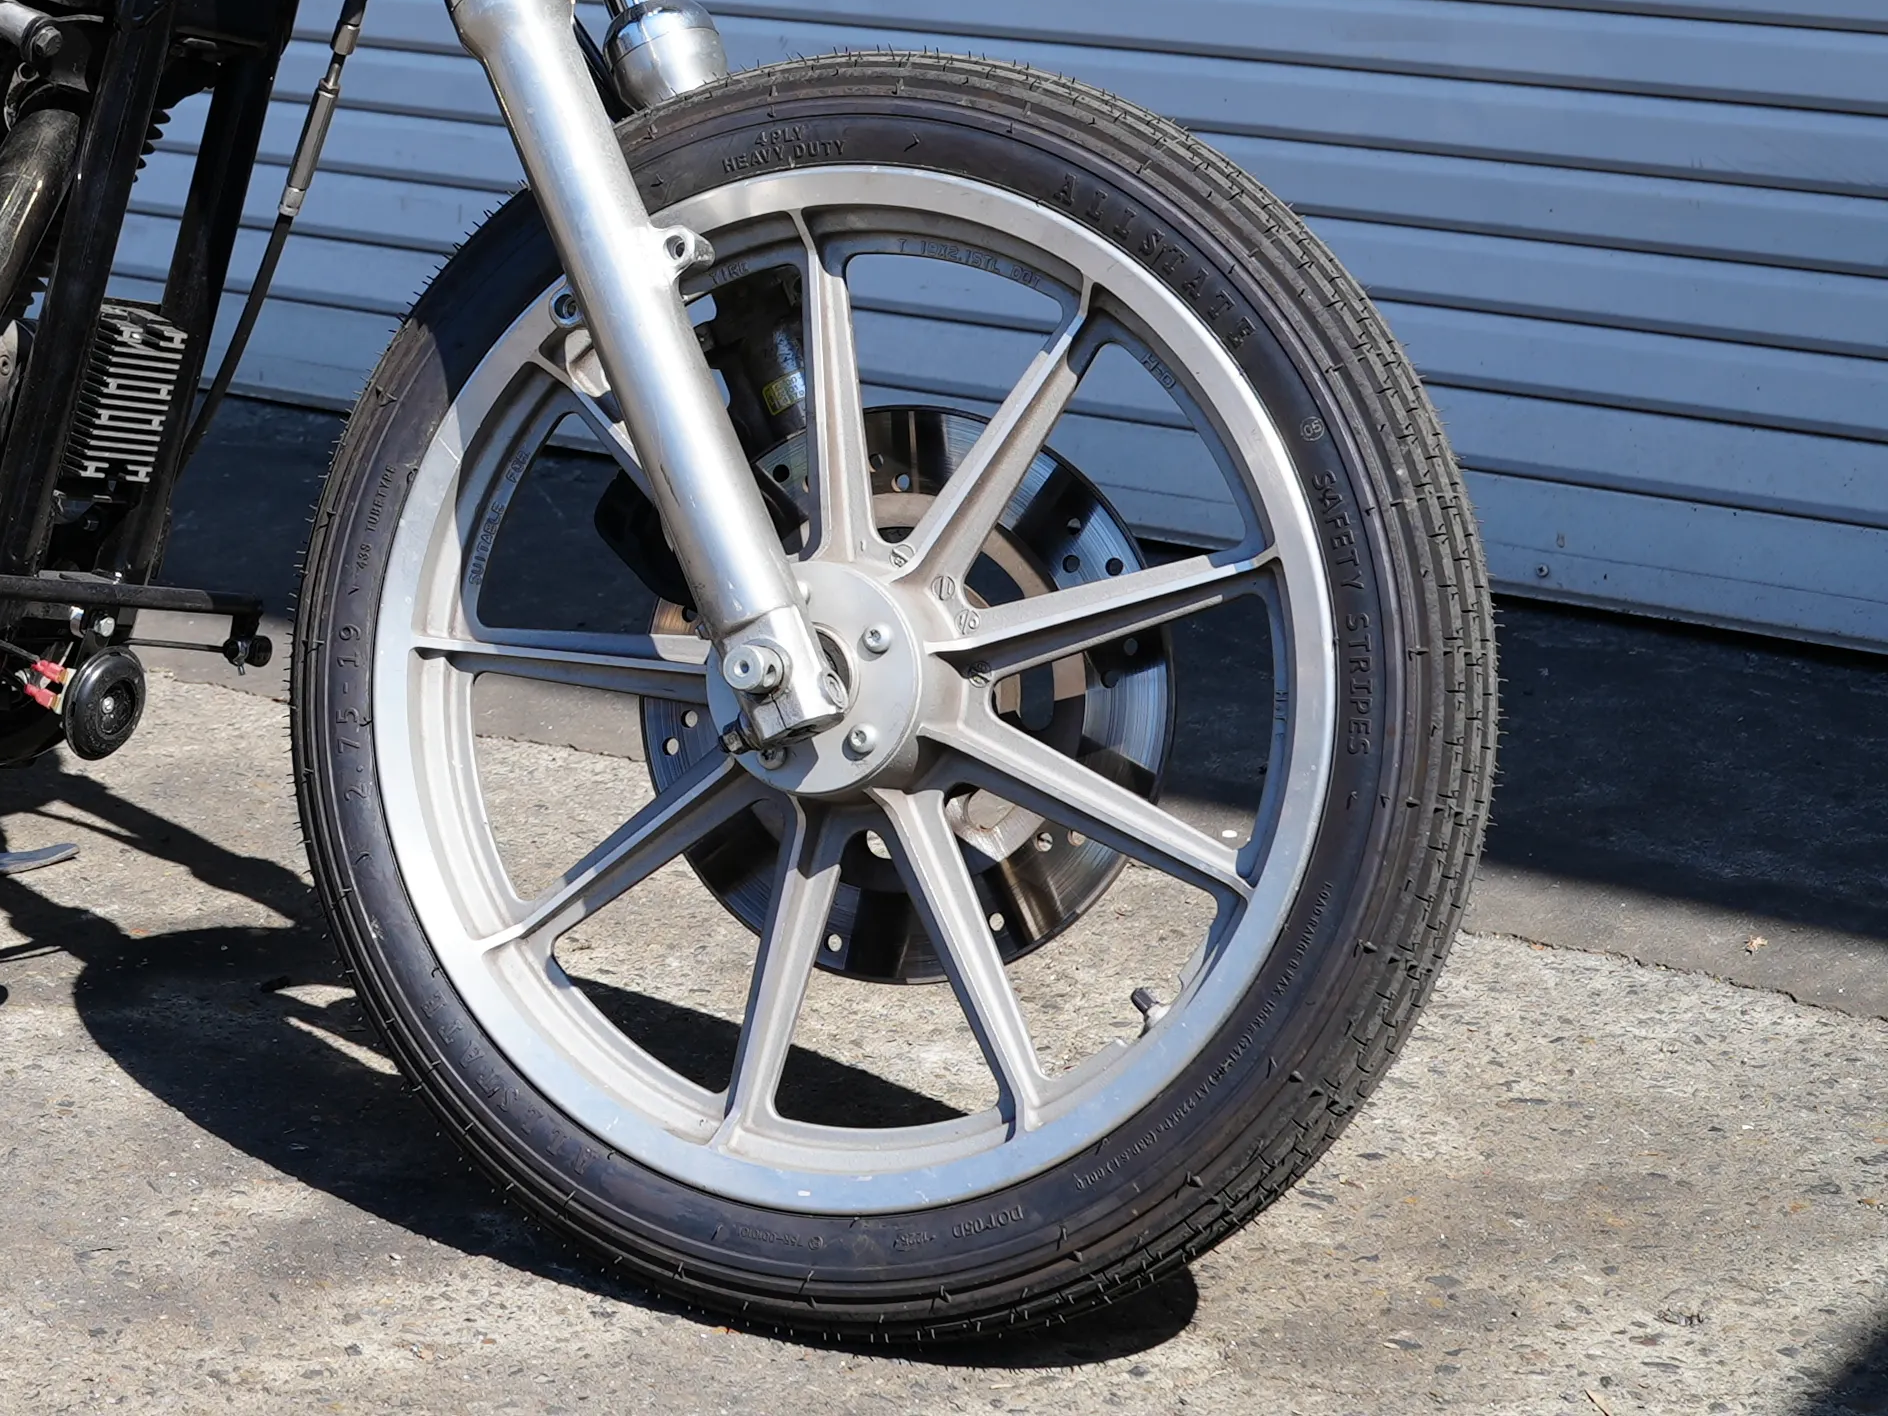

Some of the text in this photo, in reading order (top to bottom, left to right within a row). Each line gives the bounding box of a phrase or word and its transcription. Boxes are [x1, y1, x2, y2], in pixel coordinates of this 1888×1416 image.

[722, 139, 846, 174] HEAVY DUTY
[1053, 172, 1258, 350] ALLSTATE
[468, 450, 531, 586] SUITABLE FOR
[336, 623, 369, 802] 2.75-19
[365, 464, 397, 532] TUBETYPE
[1314, 470, 1372, 755] SAFETY STRIPES
[420, 989, 600, 1176] ALLSTATE
